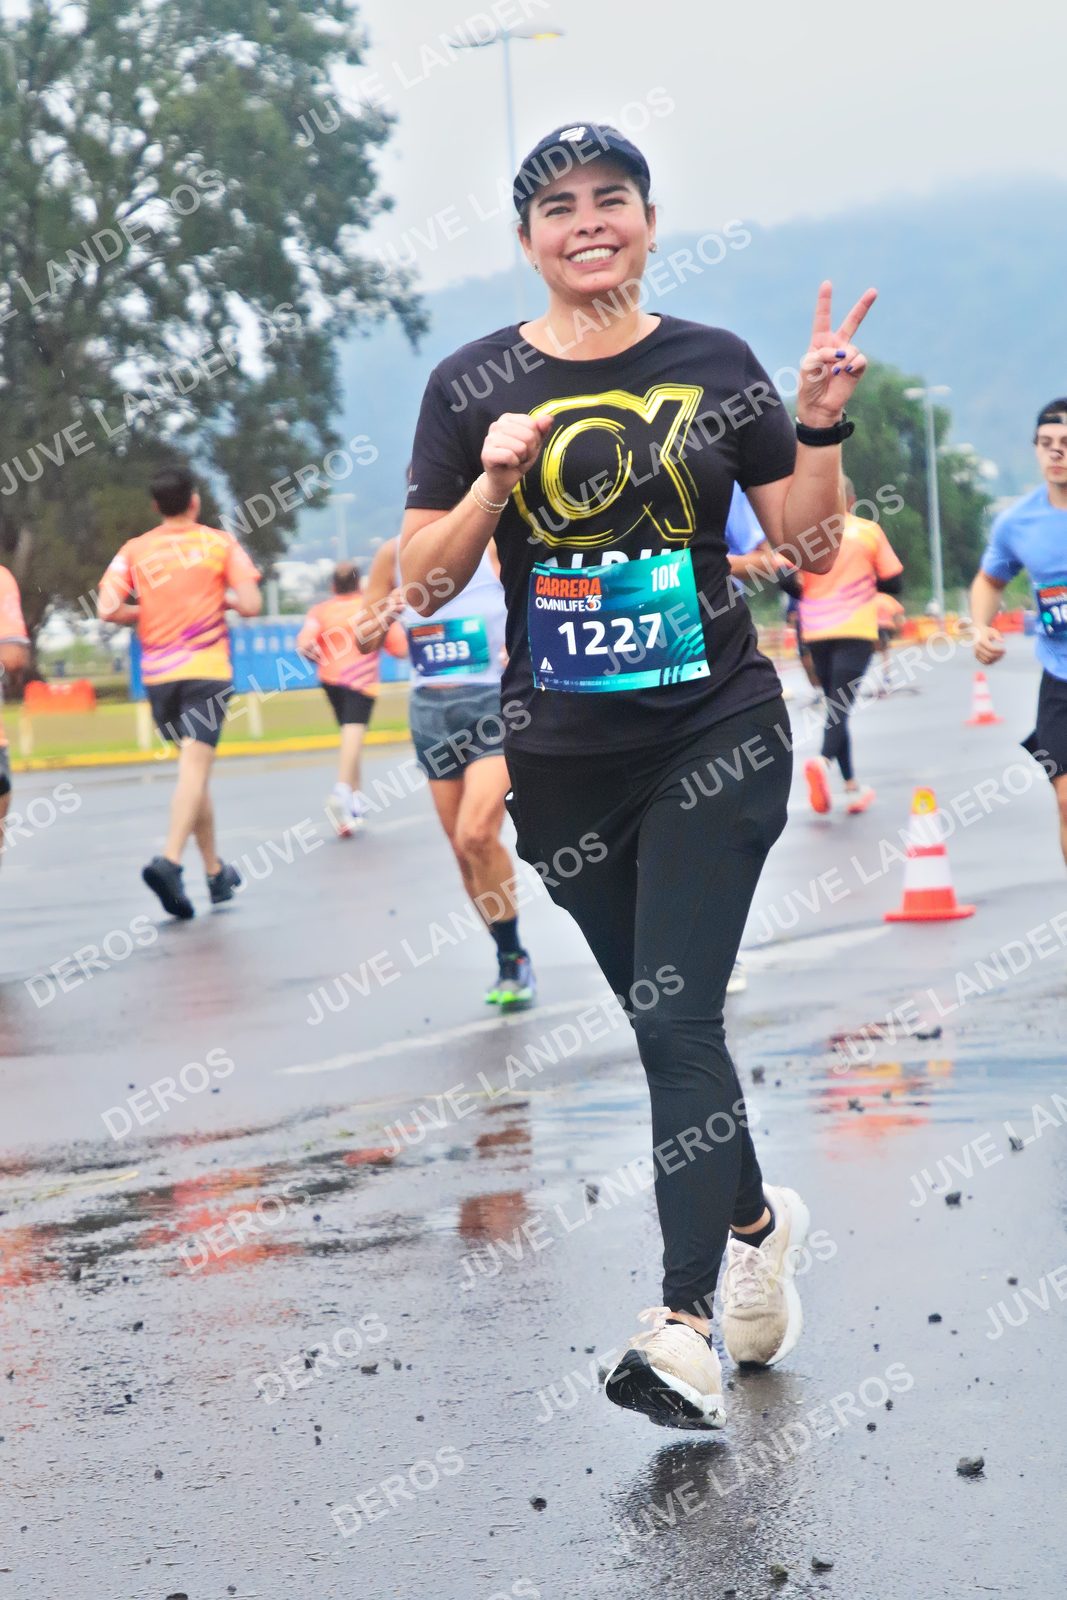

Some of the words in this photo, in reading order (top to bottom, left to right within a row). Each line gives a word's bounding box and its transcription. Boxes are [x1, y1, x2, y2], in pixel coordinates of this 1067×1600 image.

[535, 575, 602, 598] CARRERA
[650, 562, 681, 592] 10K
[557, 612, 662, 656] 1227
[423, 640, 471, 663] 1333
